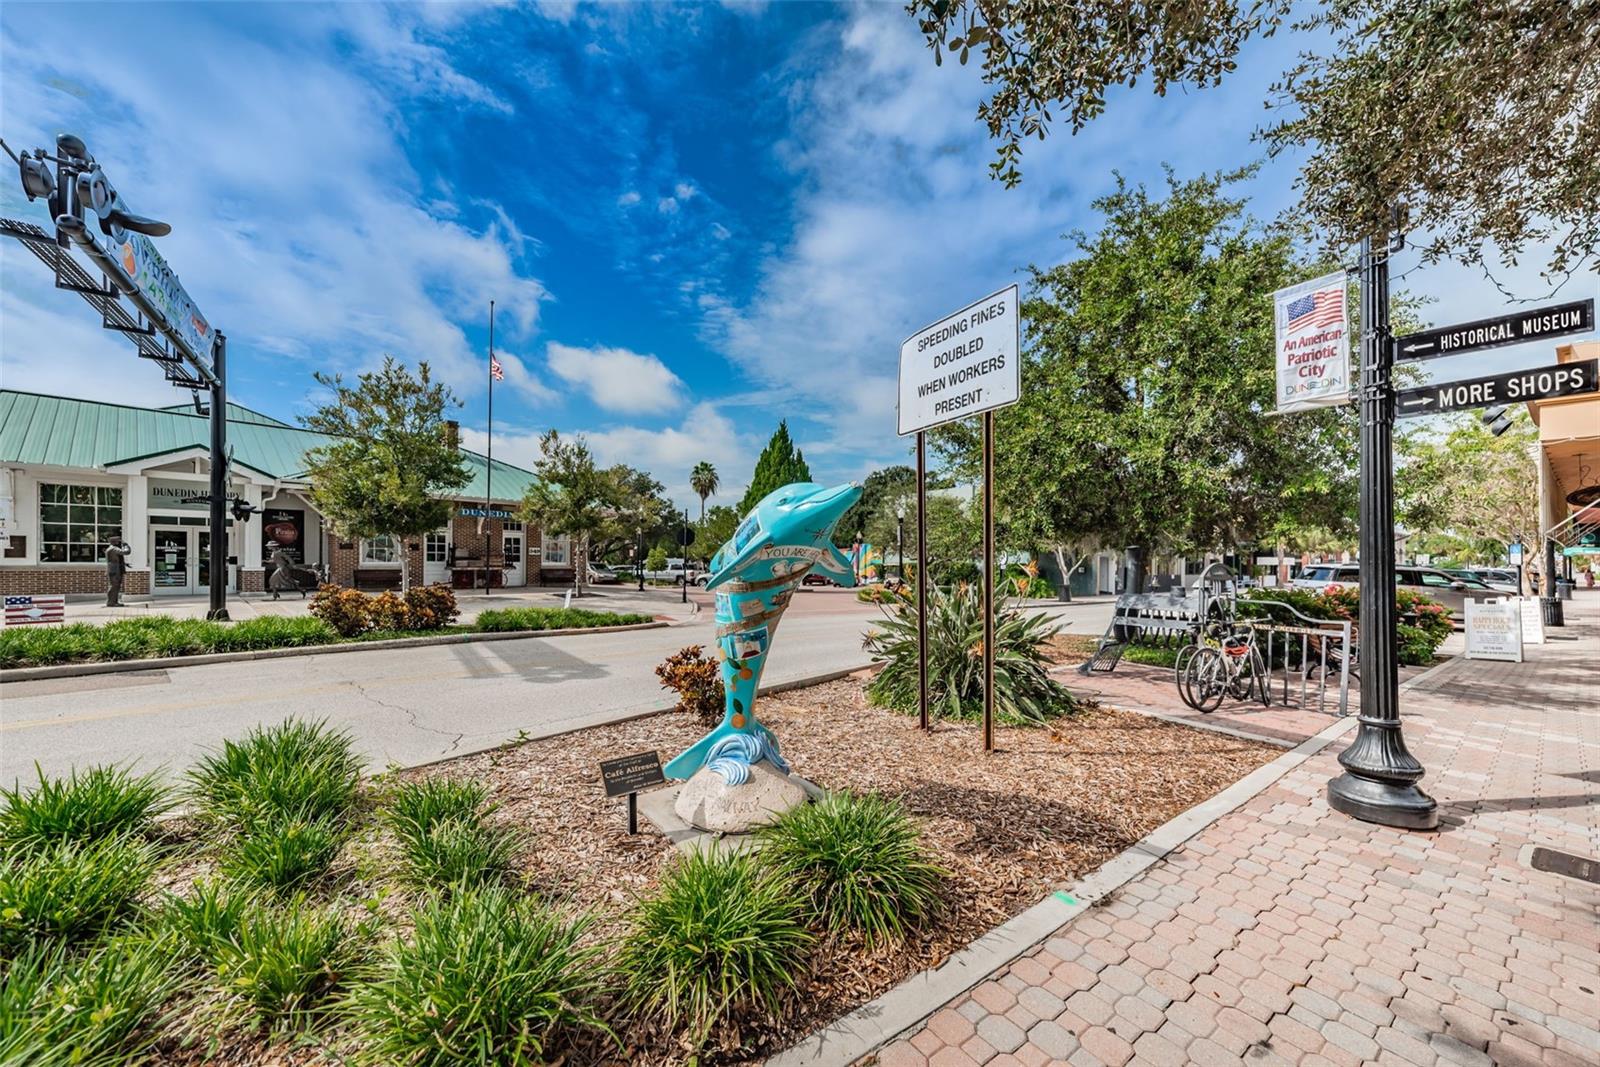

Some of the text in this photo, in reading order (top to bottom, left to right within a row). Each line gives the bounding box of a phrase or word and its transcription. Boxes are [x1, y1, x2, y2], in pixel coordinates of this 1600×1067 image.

[918, 301, 1006, 352] SPEEDING FINES
[1440, 310, 1581, 350] HISTORICAL MUSEUM
[1283, 329, 1342, 352] An American
[934, 337, 984, 369] DOUBLED
[1287, 345, 1337, 366] Patriotic
[918, 354, 1006, 398] WHEN WORKERS
[1299, 364, 1326, 378] City
[1285, 376, 1342, 395] DUNEDIN
[1438, 368, 1584, 408] MORE SHOPS
[935, 388, 983, 416] PRESENT
[152, 487, 198, 498] DUNEDIN
[766, 548, 790, 558] YOU
[604, 769, 624, 779] Café
[626, 762, 659, 775] Alfresco
